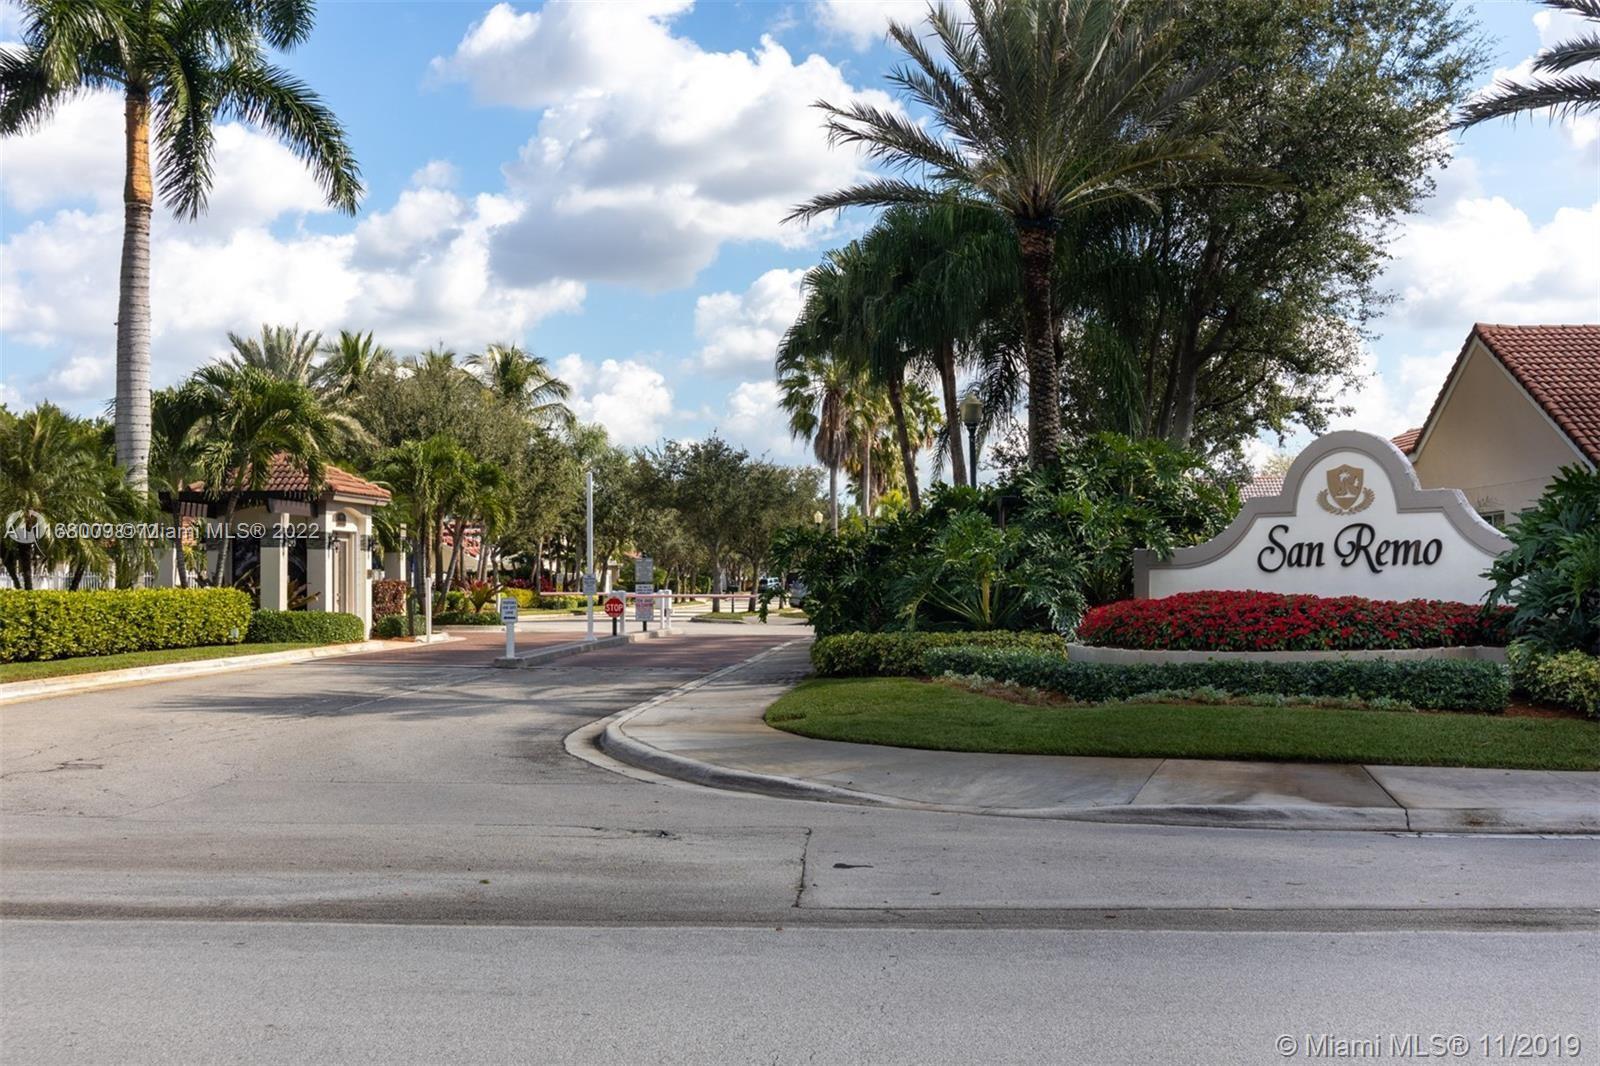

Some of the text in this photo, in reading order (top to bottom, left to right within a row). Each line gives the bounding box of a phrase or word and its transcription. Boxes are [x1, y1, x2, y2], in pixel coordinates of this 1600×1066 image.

[1257, 523, 1443, 574] San Remo
[605, 603, 623, 612] STOP
